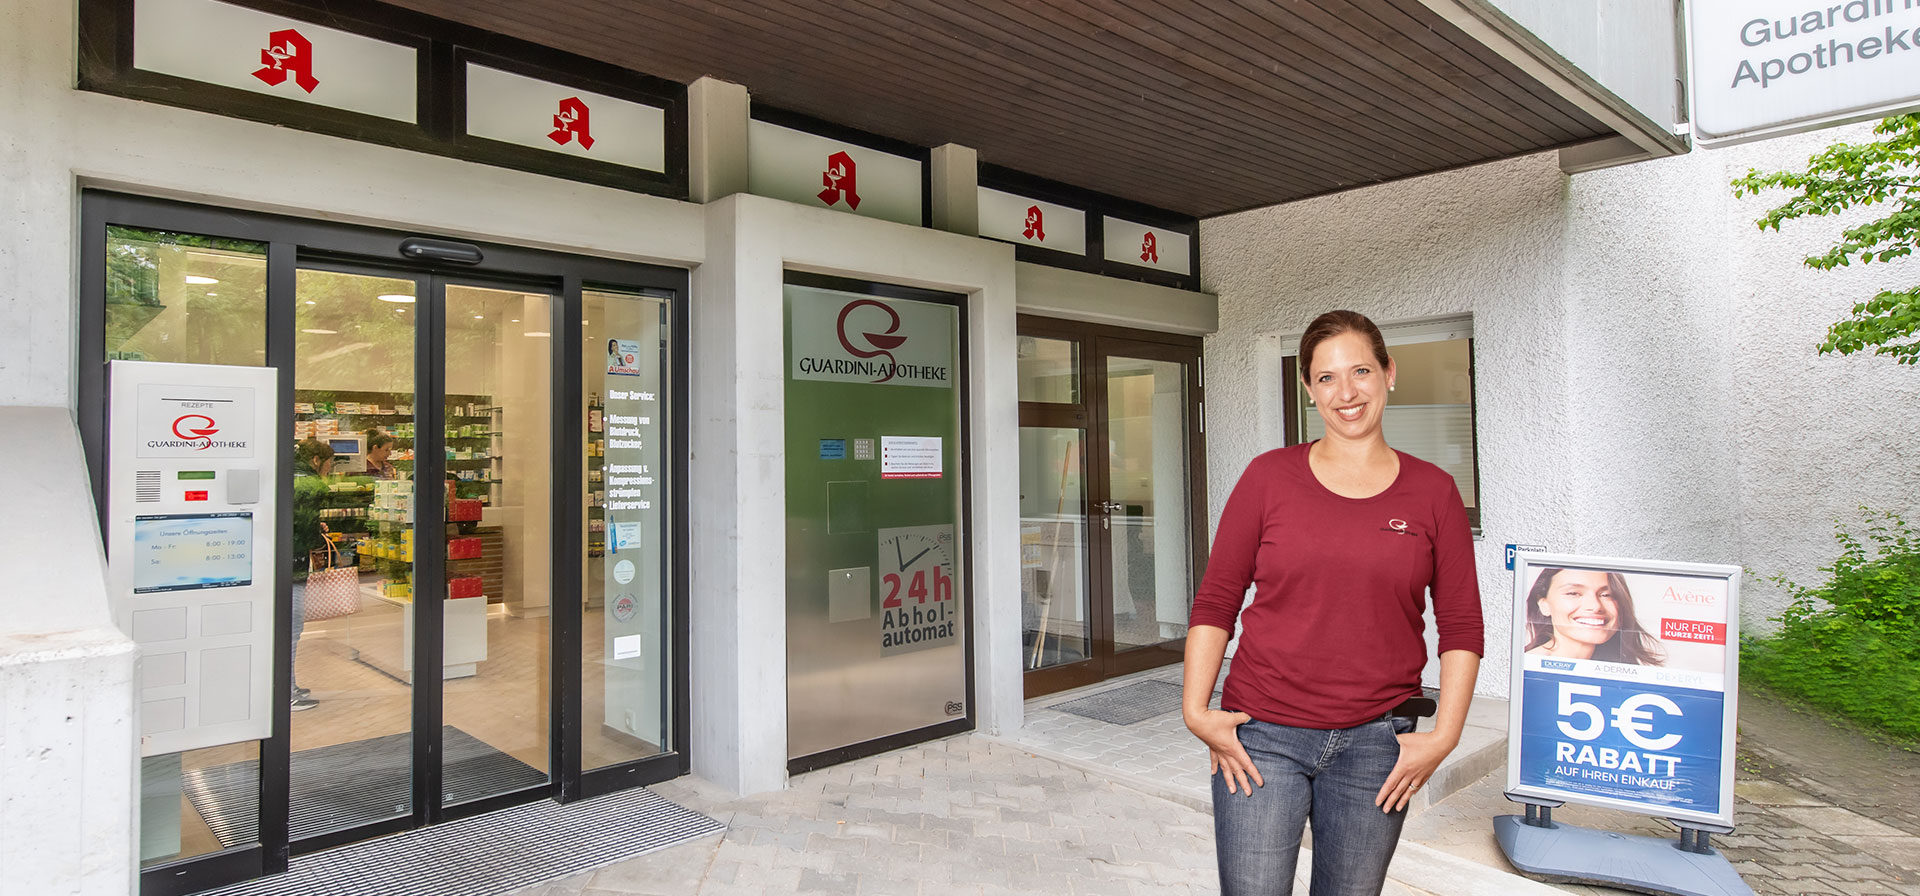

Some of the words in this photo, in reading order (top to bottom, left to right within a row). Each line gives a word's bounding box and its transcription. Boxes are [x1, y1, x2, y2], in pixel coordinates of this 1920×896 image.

[1740, 0, 1920, 46] Guardi
[799, 357, 947, 381] GUARDINI-APOTHEKE
[609, 390, 629, 400] Unser
[629, 390, 655, 401] Service:
[609, 414, 638, 426] Messung
[639, 416, 650, 425] von
[609, 427, 641, 438] Blutdruck,
[147, 440, 247, 449] GUARDINI-APOTHEKE
[609, 439, 643, 450] Blutzucker,
[609, 464, 642, 475] Anpassung
[609, 476, 655, 487] Kompressions-
[609, 488, 641, 499] strümpfen
[609, 500, 650, 511] Lieferservice
[183, 528, 228, 537] Öffnungszeiten
[1506, 548, 1515, 564] P
[882, 565, 952, 609] 24h
[1662, 585, 1716, 604] Avène
[882, 601, 953, 631] Abhol-
[1665, 621, 1689, 632] NUR
[1692, 623, 1714, 634] FÜR
[882, 620, 954, 648] automat
[1665, 630, 1692, 639] KURZE
[1693, 633, 1714, 641] ZEIT!
[1544, 660, 1572, 669] DUCRAY
[946, 702, 962, 712] PSS
[1556, 741, 1682, 777] RABATT
[1555, 765, 1579, 777] AUF
[1582, 768, 1618, 783] IHREN
